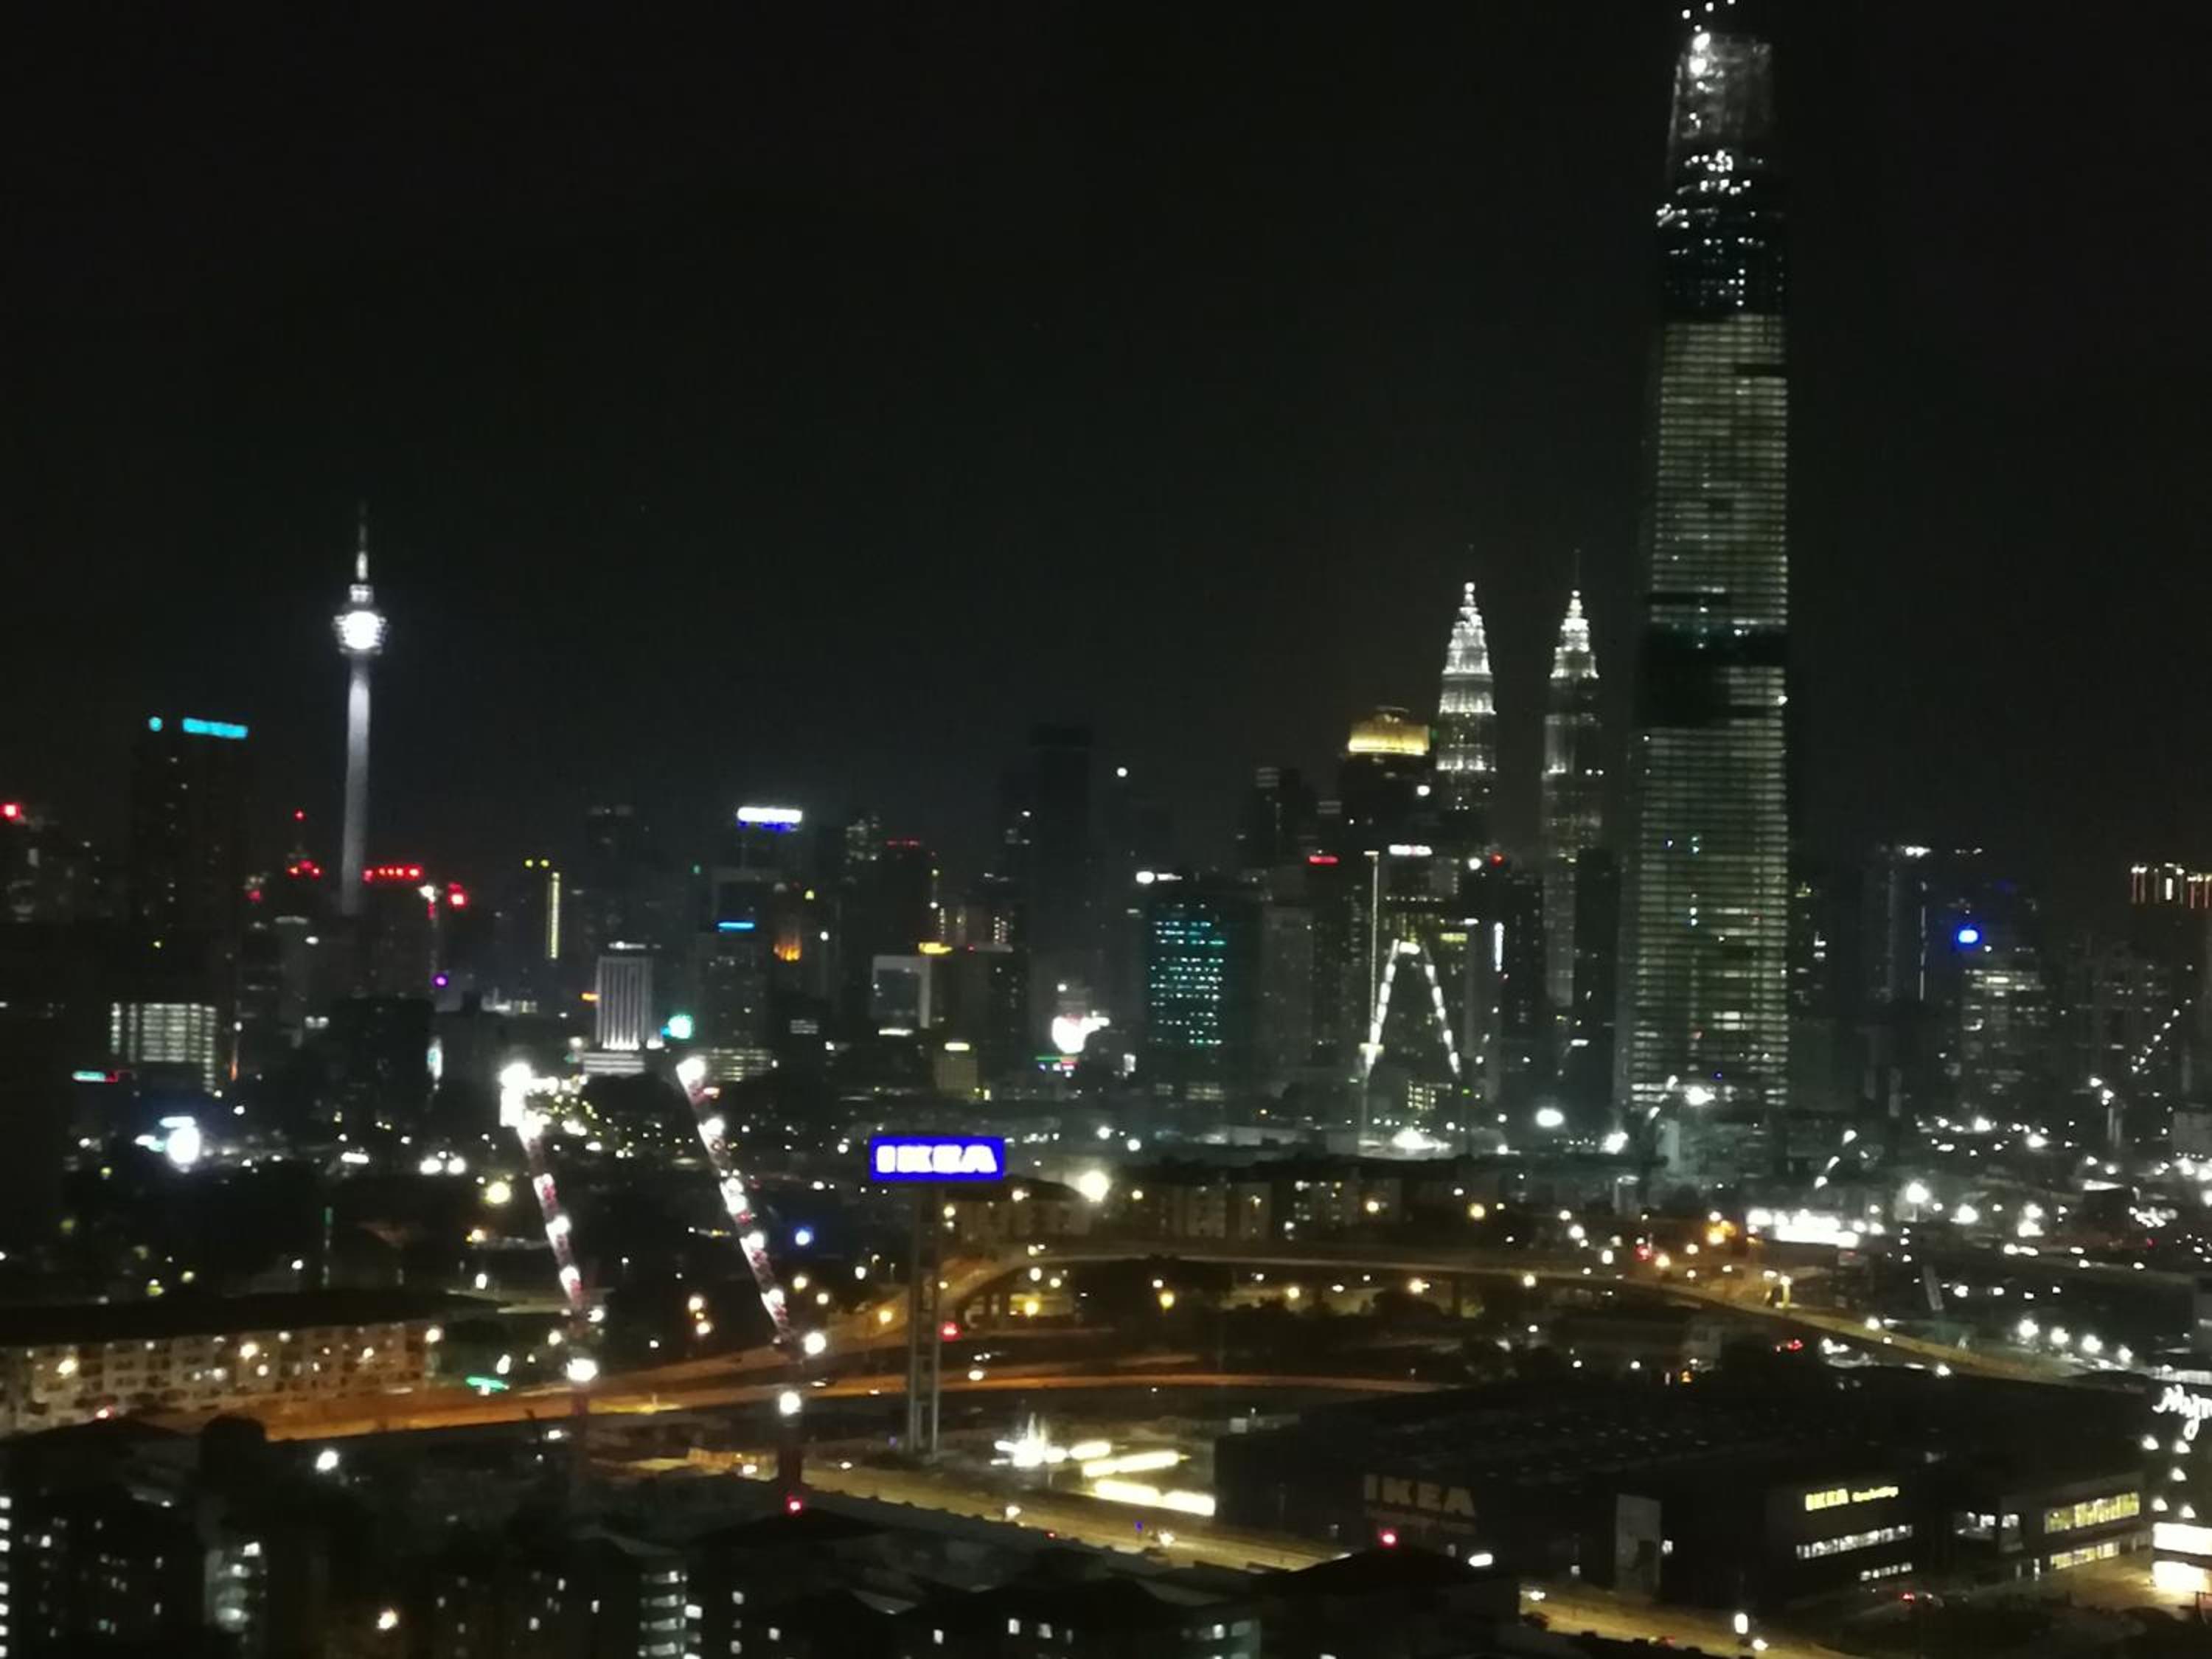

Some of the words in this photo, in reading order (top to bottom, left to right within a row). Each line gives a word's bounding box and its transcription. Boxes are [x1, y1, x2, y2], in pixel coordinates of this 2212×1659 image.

[876, 1144, 998, 1174] IKEA
[1364, 1474, 1475, 1516] IKEA
[1805, 1488, 1848, 1511] IKEA
